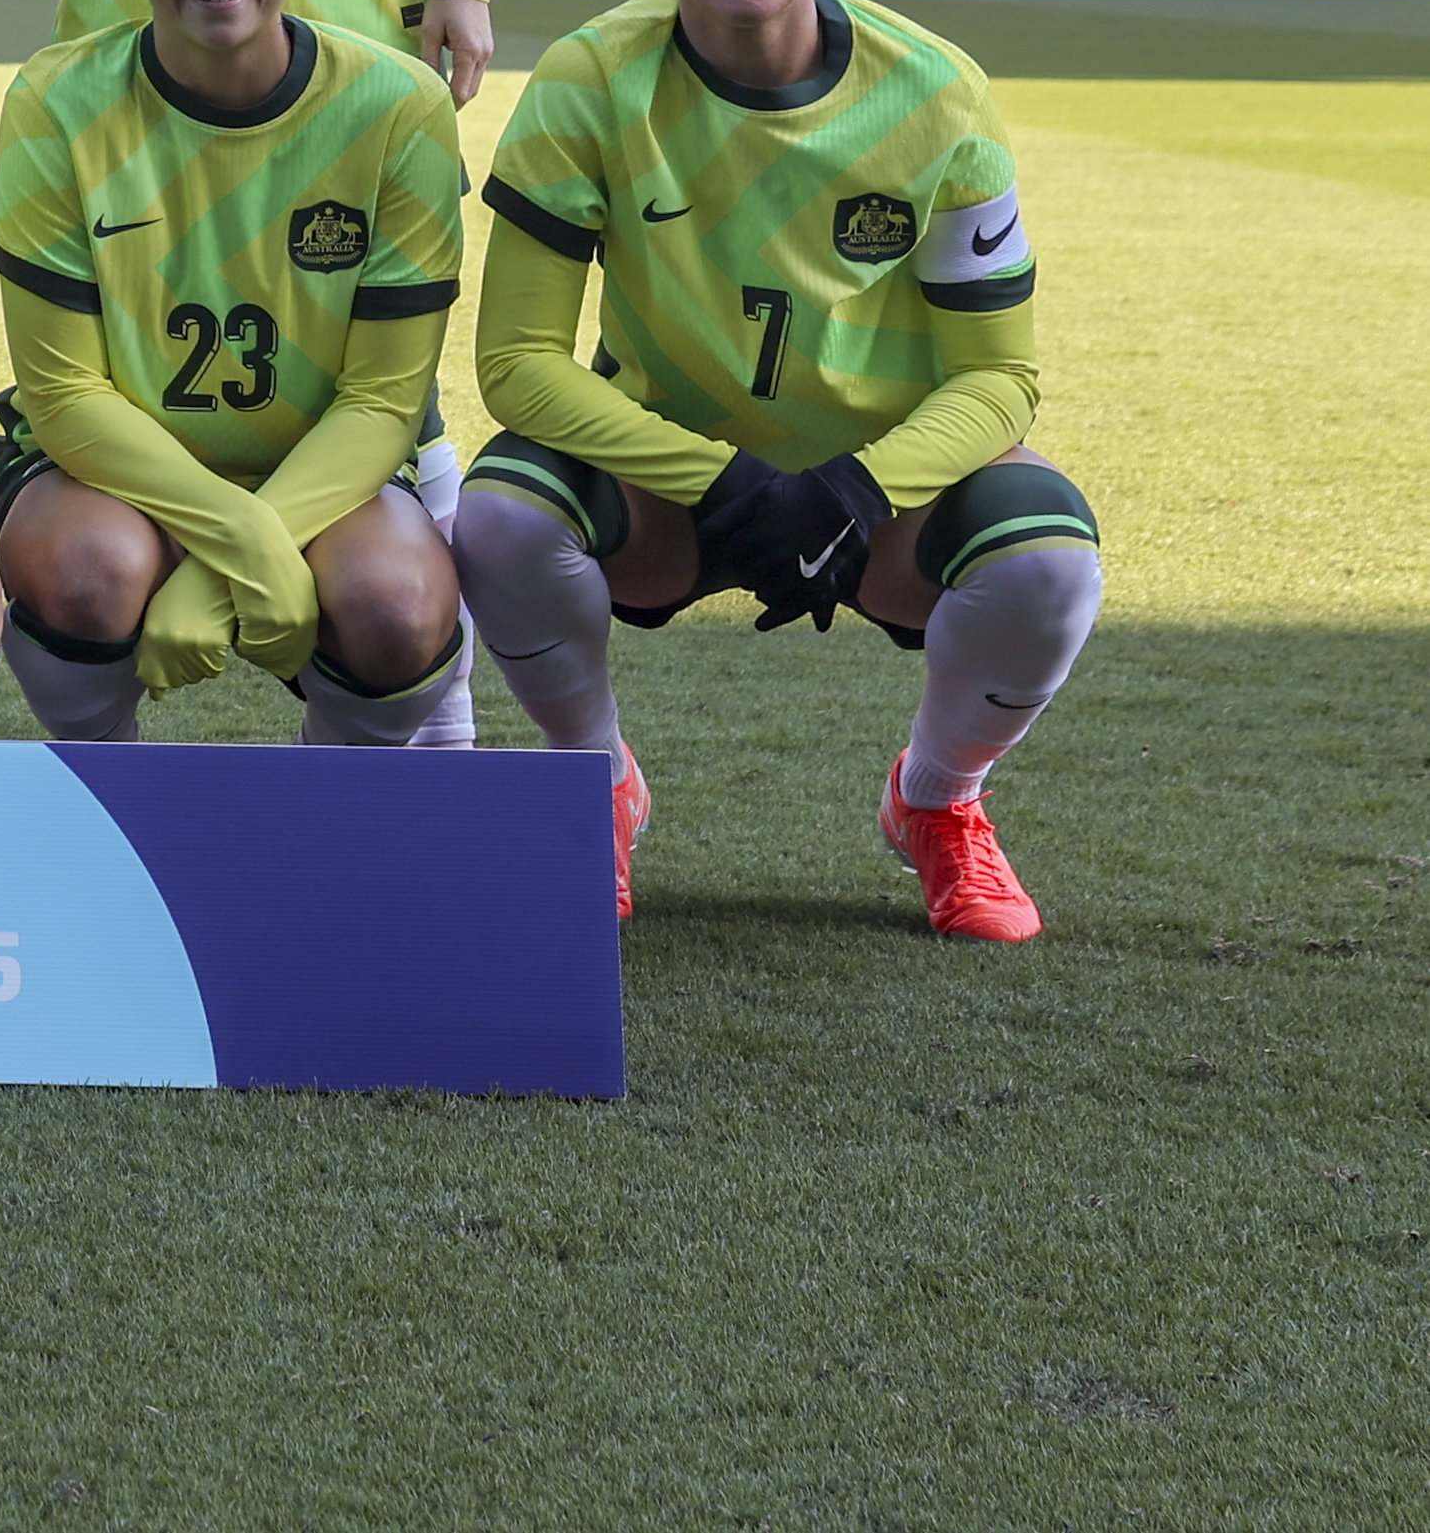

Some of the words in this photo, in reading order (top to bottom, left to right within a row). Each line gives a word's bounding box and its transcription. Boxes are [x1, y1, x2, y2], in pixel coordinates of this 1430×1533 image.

[302, 245, 355, 254] AUSTRALIA
[848, 235, 903, 244] AUSTRALIA
[162, 303, 278, 412] 23
[741, 285, 793, 400] 7
